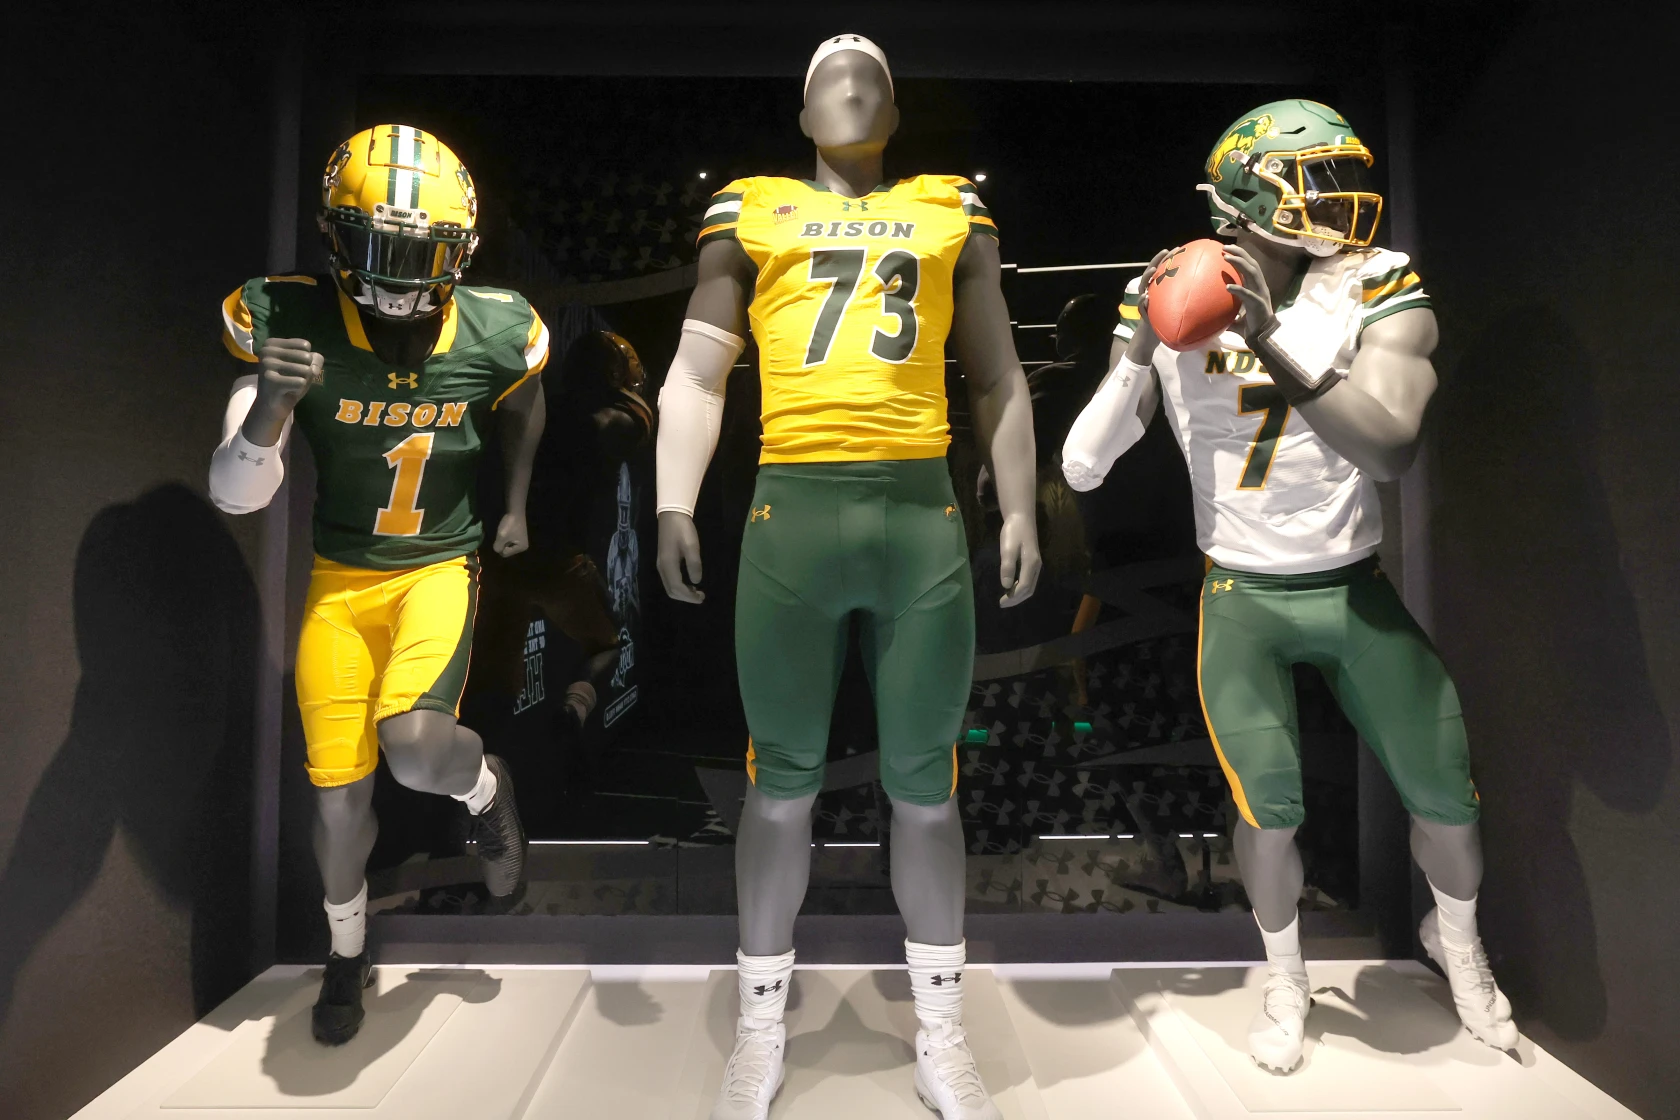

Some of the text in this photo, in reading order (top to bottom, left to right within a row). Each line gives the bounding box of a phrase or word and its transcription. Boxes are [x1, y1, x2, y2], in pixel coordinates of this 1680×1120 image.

[390, 210, 413, 219] BISON
[800, 221, 915, 239] BISON
[802, 246, 921, 369] 73
[335, 398, 468, 427] BISON
[1235, 382, 1292, 491] 7
[372, 432, 435, 537] 1
